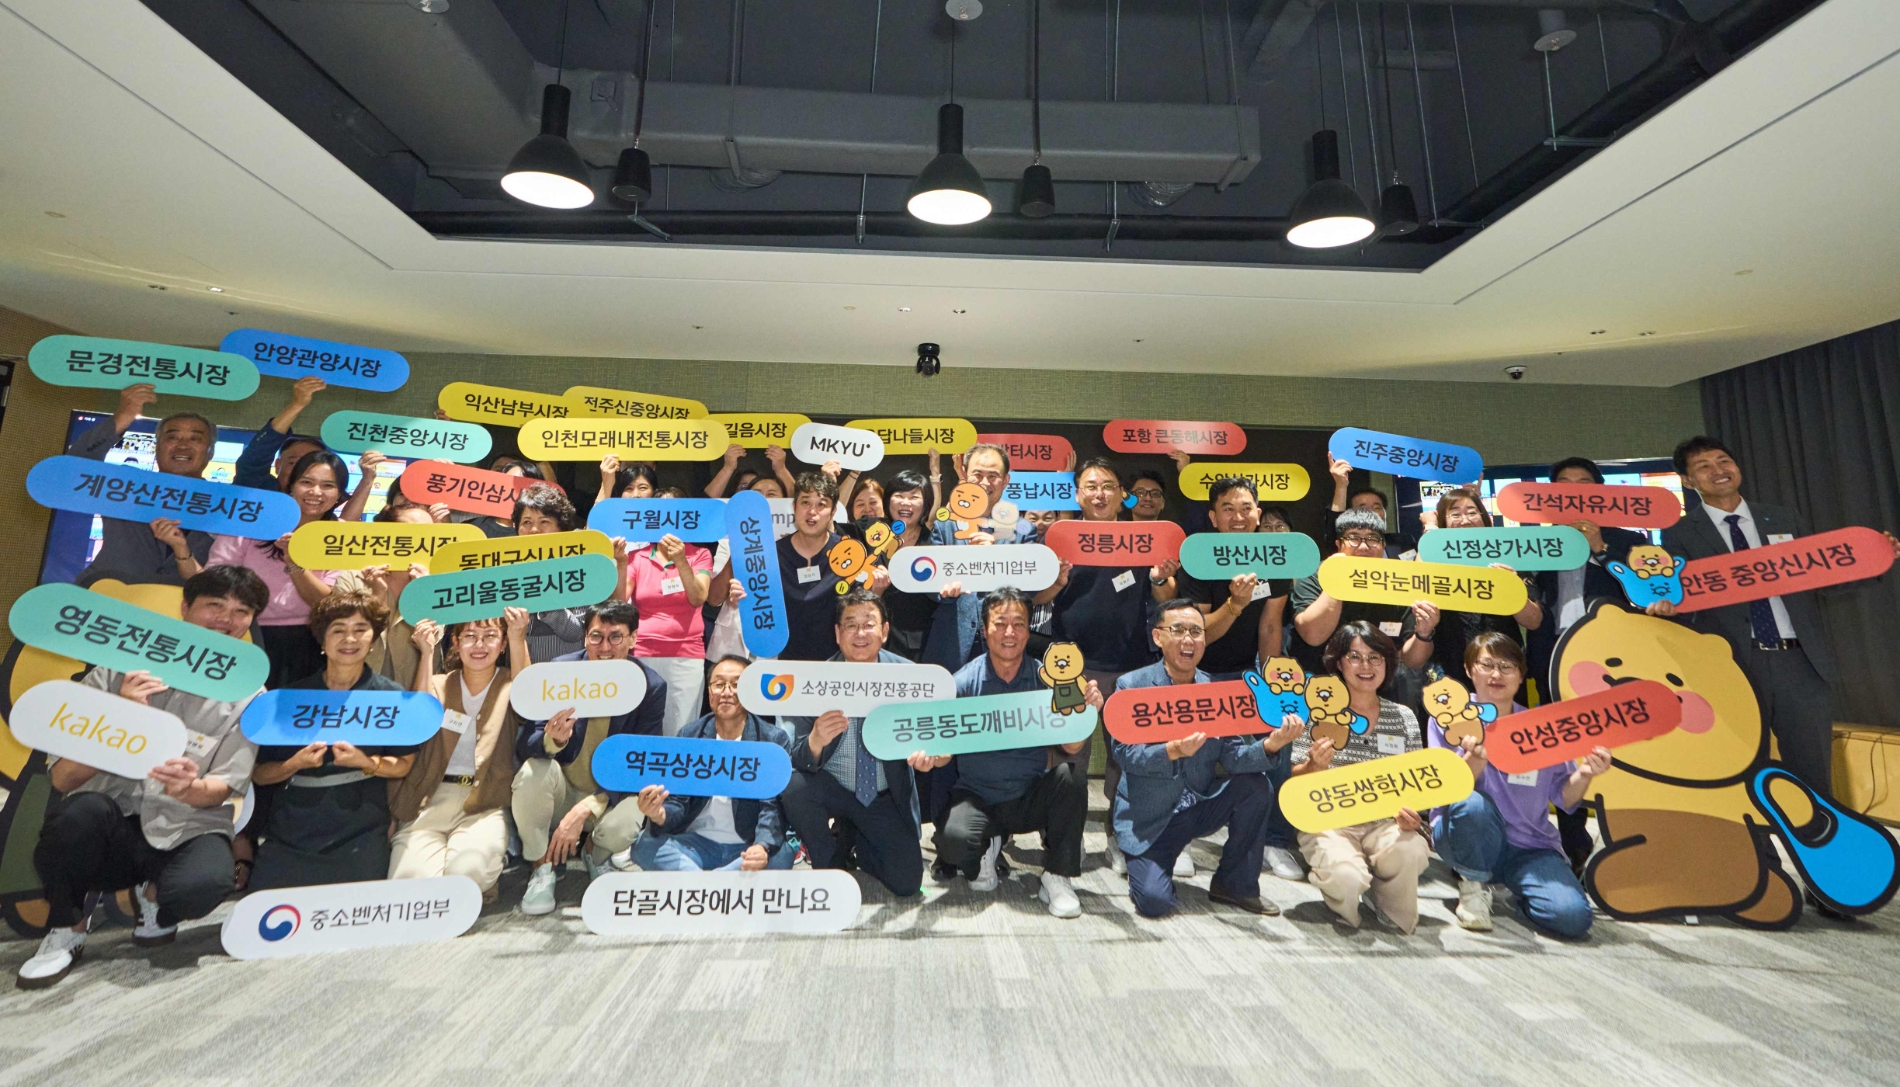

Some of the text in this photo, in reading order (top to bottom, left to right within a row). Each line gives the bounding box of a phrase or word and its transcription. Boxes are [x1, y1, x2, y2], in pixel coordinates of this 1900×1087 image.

[66, 350, 230, 386] 문경전통시장
[254, 342, 382, 378] 안양관양시장
[464, 393, 569, 419] 익산남부시장
[584, 396, 690, 419] 전주신중앙시장
[347, 421, 468, 450] 진천중앙시장
[541, 429, 708, 449] 인천모래내전통시장
[725, 422, 787, 438] 길음시장
[868, 428, 955, 444] 답나들시장
[1123, 428, 1228, 446] 포항 큰동해시장
[1353, 439, 1459, 473] 진주중앙시장
[73, 473, 264, 522] 계양산전통시장
[1006, 482, 1073, 499] 풍납시장
[1523, 493, 1652, 516] 간석자유시장
[622, 510, 701, 530] 구월시장
[1077, 533, 1154, 553] 정릉시장
[1213, 545, 1287, 566] 방산시장
[1442, 537, 1564, 559] 신정상가시장
[739, 516, 776, 632] 상계중앙시장
[942, 560, 1038, 577] 중소벤처기업부
[1683, 543, 1857, 596] 안동 중앙신시장
[432, 569, 587, 610] 고리울동굴시장
[1349, 568, 1495, 600] 설악눈메골시장
[54, 605, 237, 681] 영동전통시장
[541, 677, 618, 702] kakao
[800, 680, 936, 699] 소상공인시장진흥공단
[292, 704, 400, 730] 강남시장
[892, 705, 1067, 743] 공릉동도깨비시장
[1131, 695, 1257, 728] 용산용문시장
[49, 702, 147, 755] kakao
[1508, 698, 1651, 756] 안성중앙시장
[625, 751, 761, 782] 역곡상상시장
[1308, 764, 1443, 814] 양동쌍학시장
[310, 898, 450, 931] 중소벤처기업부
[613, 888, 831, 917] 단골시장에서 만나요
